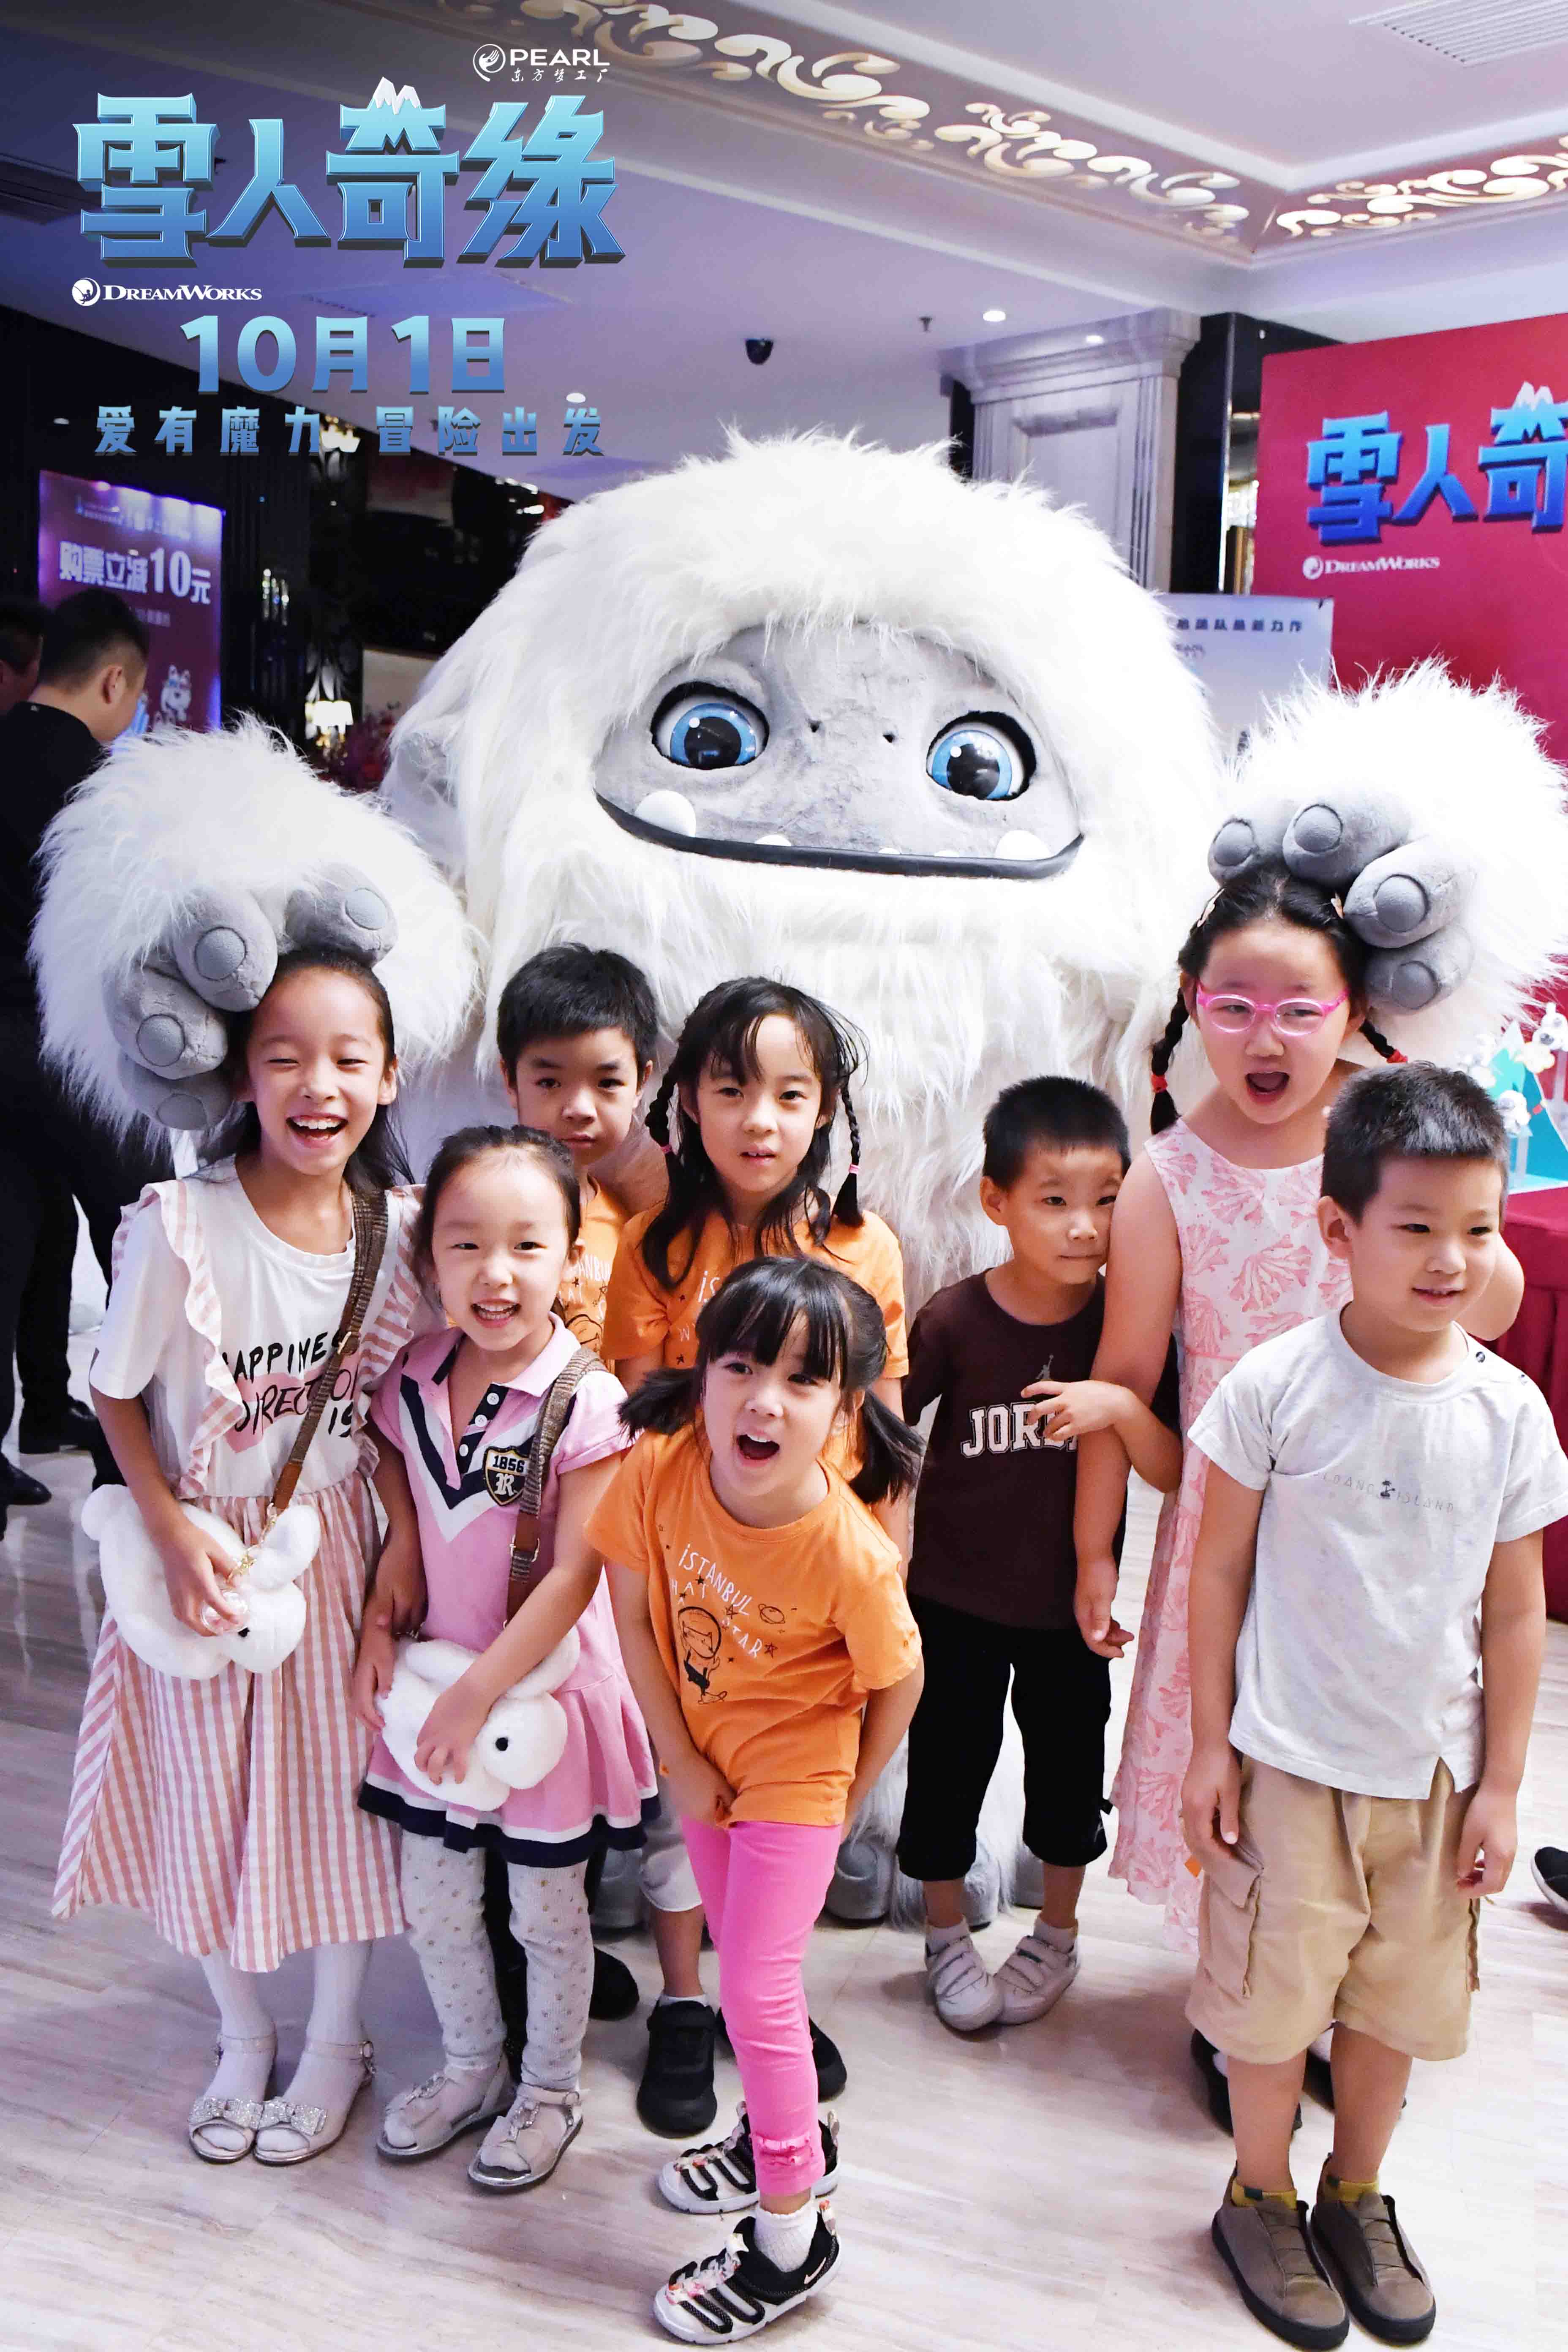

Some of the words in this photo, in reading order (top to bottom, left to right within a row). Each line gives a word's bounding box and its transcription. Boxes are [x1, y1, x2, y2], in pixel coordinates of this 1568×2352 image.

[59, 540, 211, 604] 购票立减10元
[492, 1455, 525, 1473] 1856
